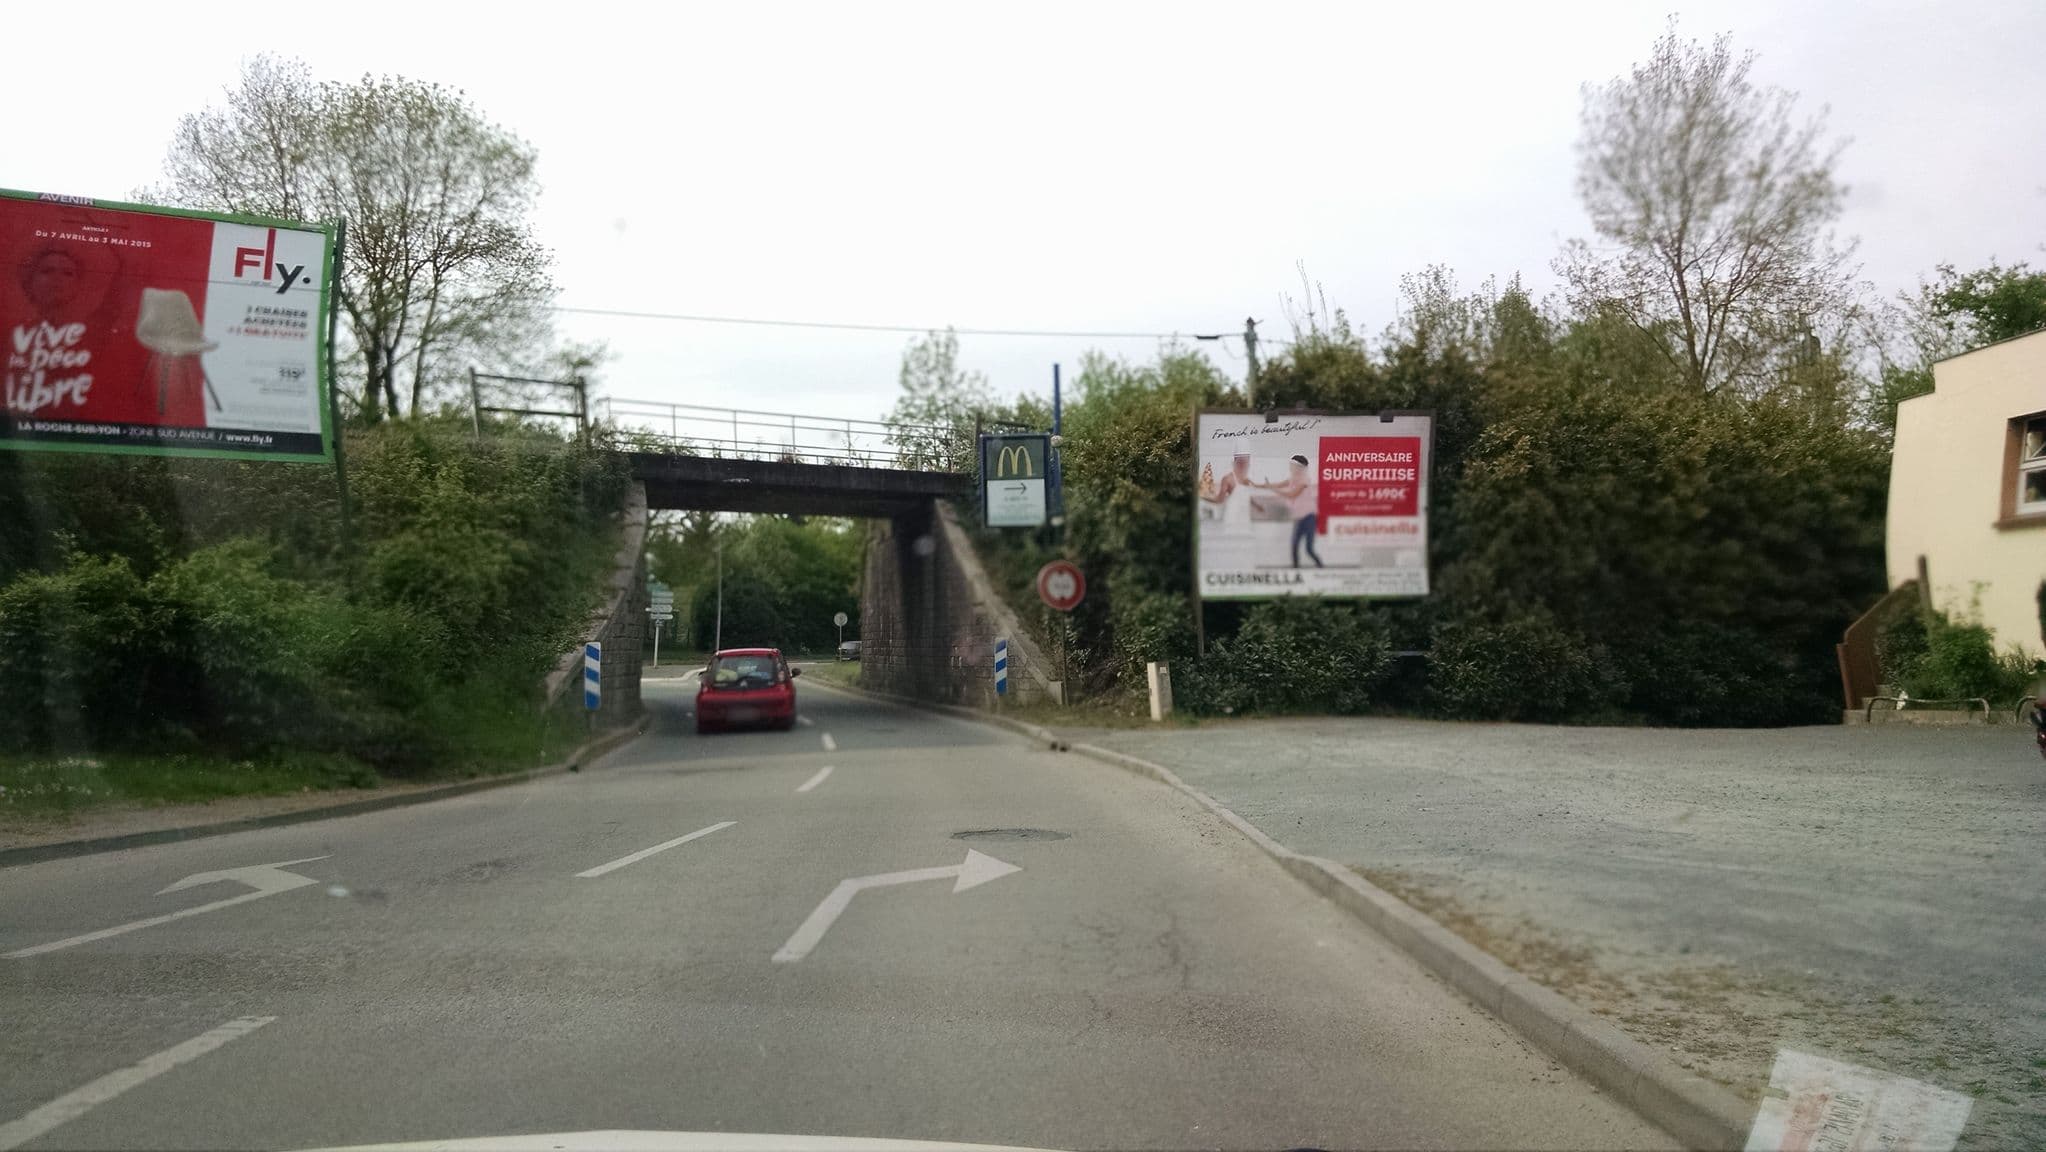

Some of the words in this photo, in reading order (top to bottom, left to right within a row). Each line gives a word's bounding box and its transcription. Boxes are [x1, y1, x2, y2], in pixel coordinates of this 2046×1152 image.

[39, 192, 95, 206] AVENIR
[35, 229, 49, 238] Du
[59, 232, 87, 242] AVRIL
[102, 236, 108, 244] 3
[110, 238, 128, 246] MAI
[130, 240, 152, 249] 2015
[179, 431, 215, 440] AVENUE
[1212, 427, 1247, 440] French
[1326, 452, 1413, 463] ANNIVERSAIRE
